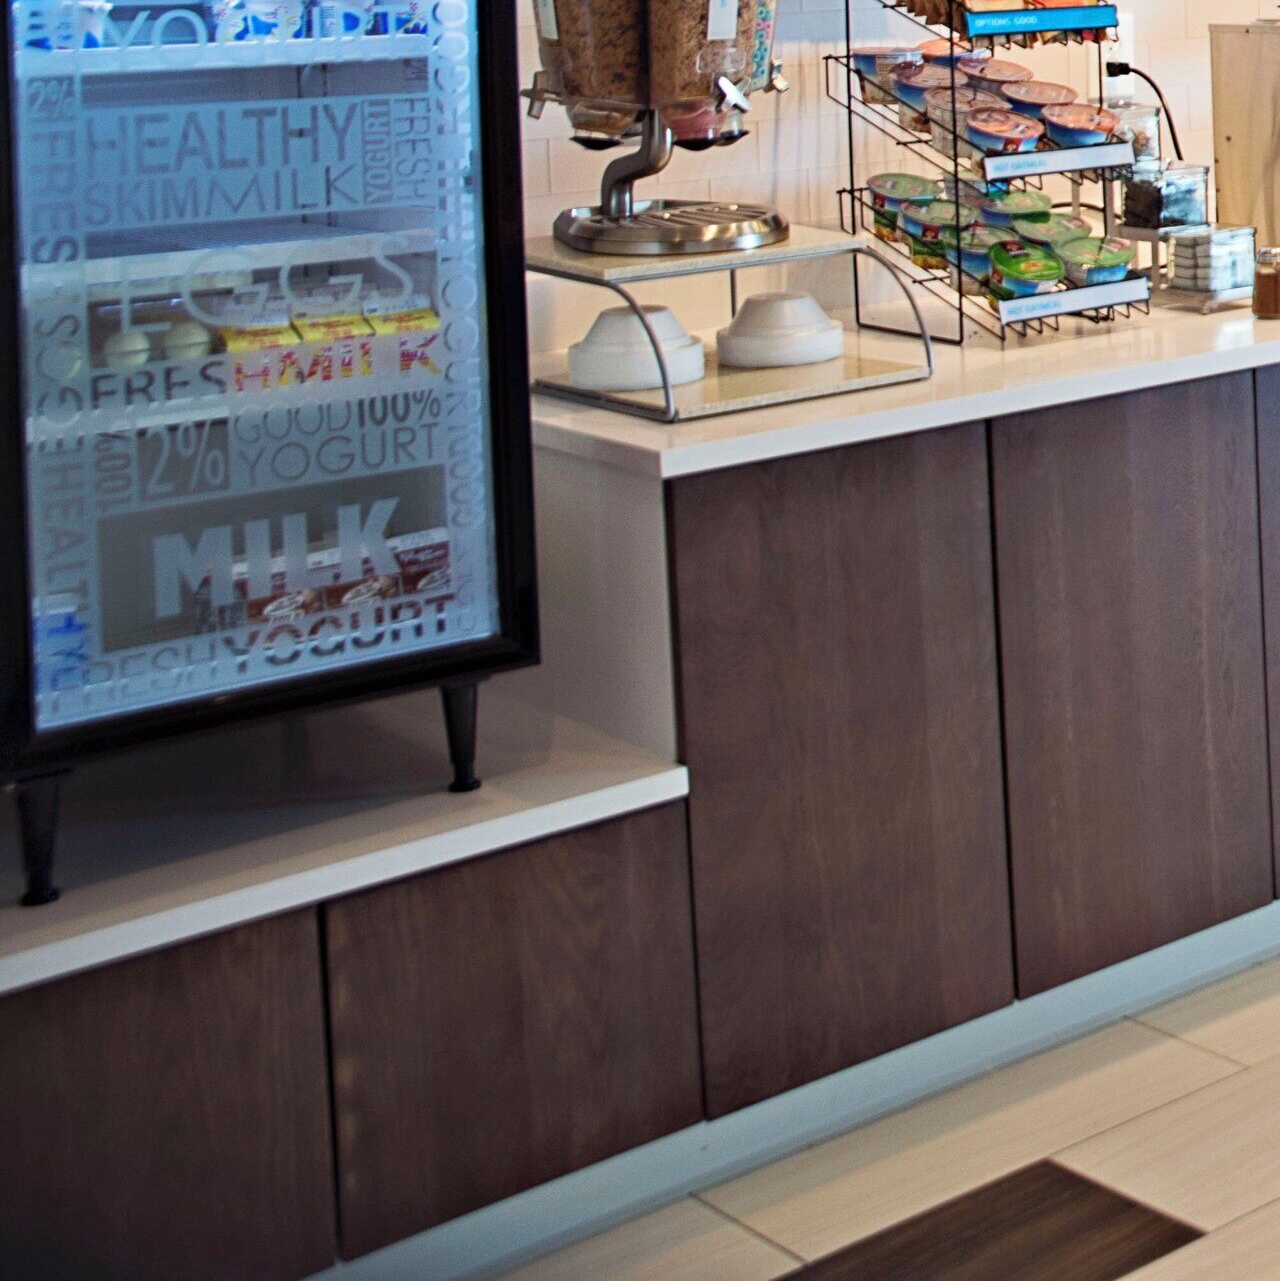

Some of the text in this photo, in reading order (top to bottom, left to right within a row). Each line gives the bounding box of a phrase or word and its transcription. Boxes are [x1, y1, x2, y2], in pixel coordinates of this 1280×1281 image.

[86, 101, 358, 177] HEALTHY
[363, 102, 391, 203] YOGURT
[31, 129, 80, 293] FRES
[84, 164, 360, 227] SKIM MILK
[233, 387, 443, 445] GOOD 100%
[238, 421, 441, 486] YOGURT
[144, 418, 227, 494] 2%
[154, 497, 401, 619] MILK
[225, 591, 456, 673] YOGURT
